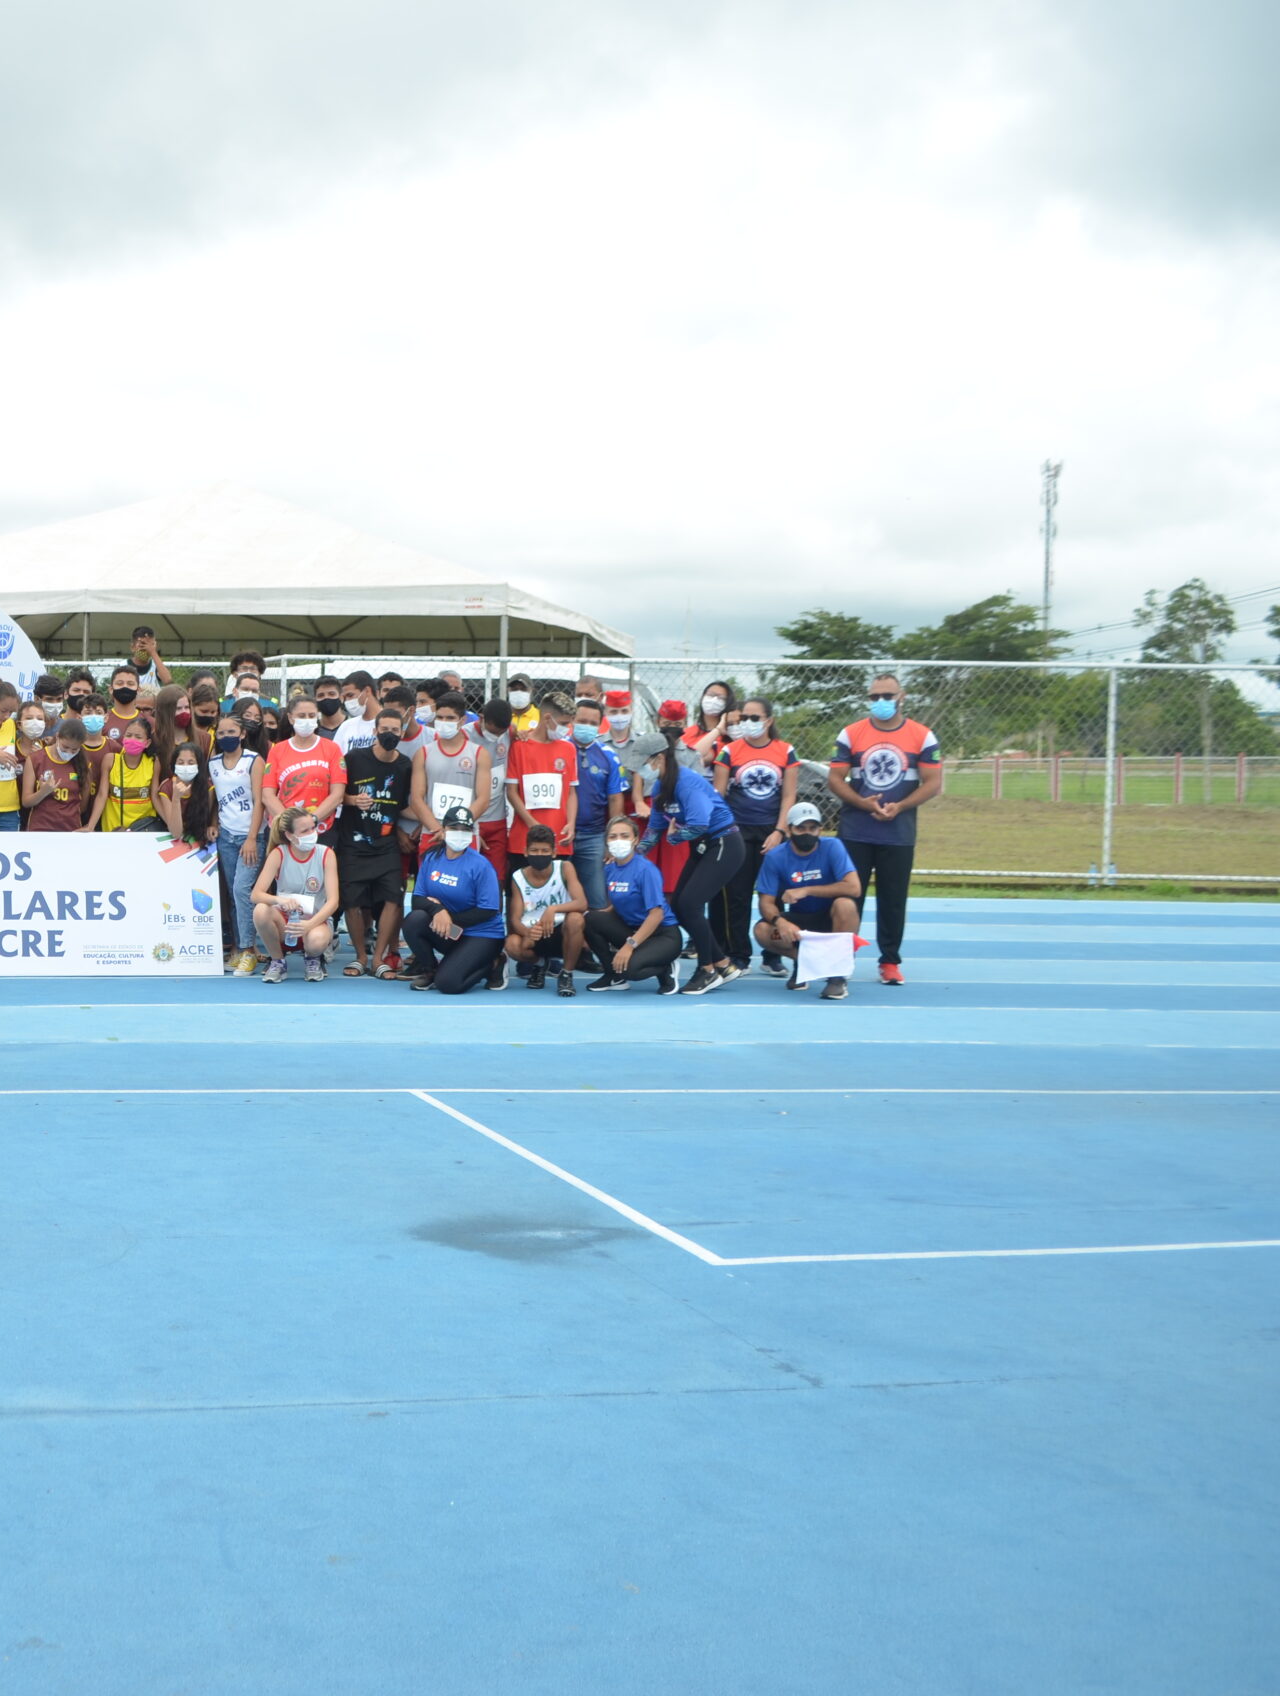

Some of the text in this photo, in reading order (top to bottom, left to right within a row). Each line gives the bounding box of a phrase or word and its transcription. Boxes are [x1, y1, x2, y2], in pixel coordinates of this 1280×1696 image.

[53, 787, 69, 802] 30
[532, 783, 556, 798] 990
[238, 799, 251, 813] 15
[192, 915, 214, 923] CBDE
[179, 945, 214, 955] ACRE
